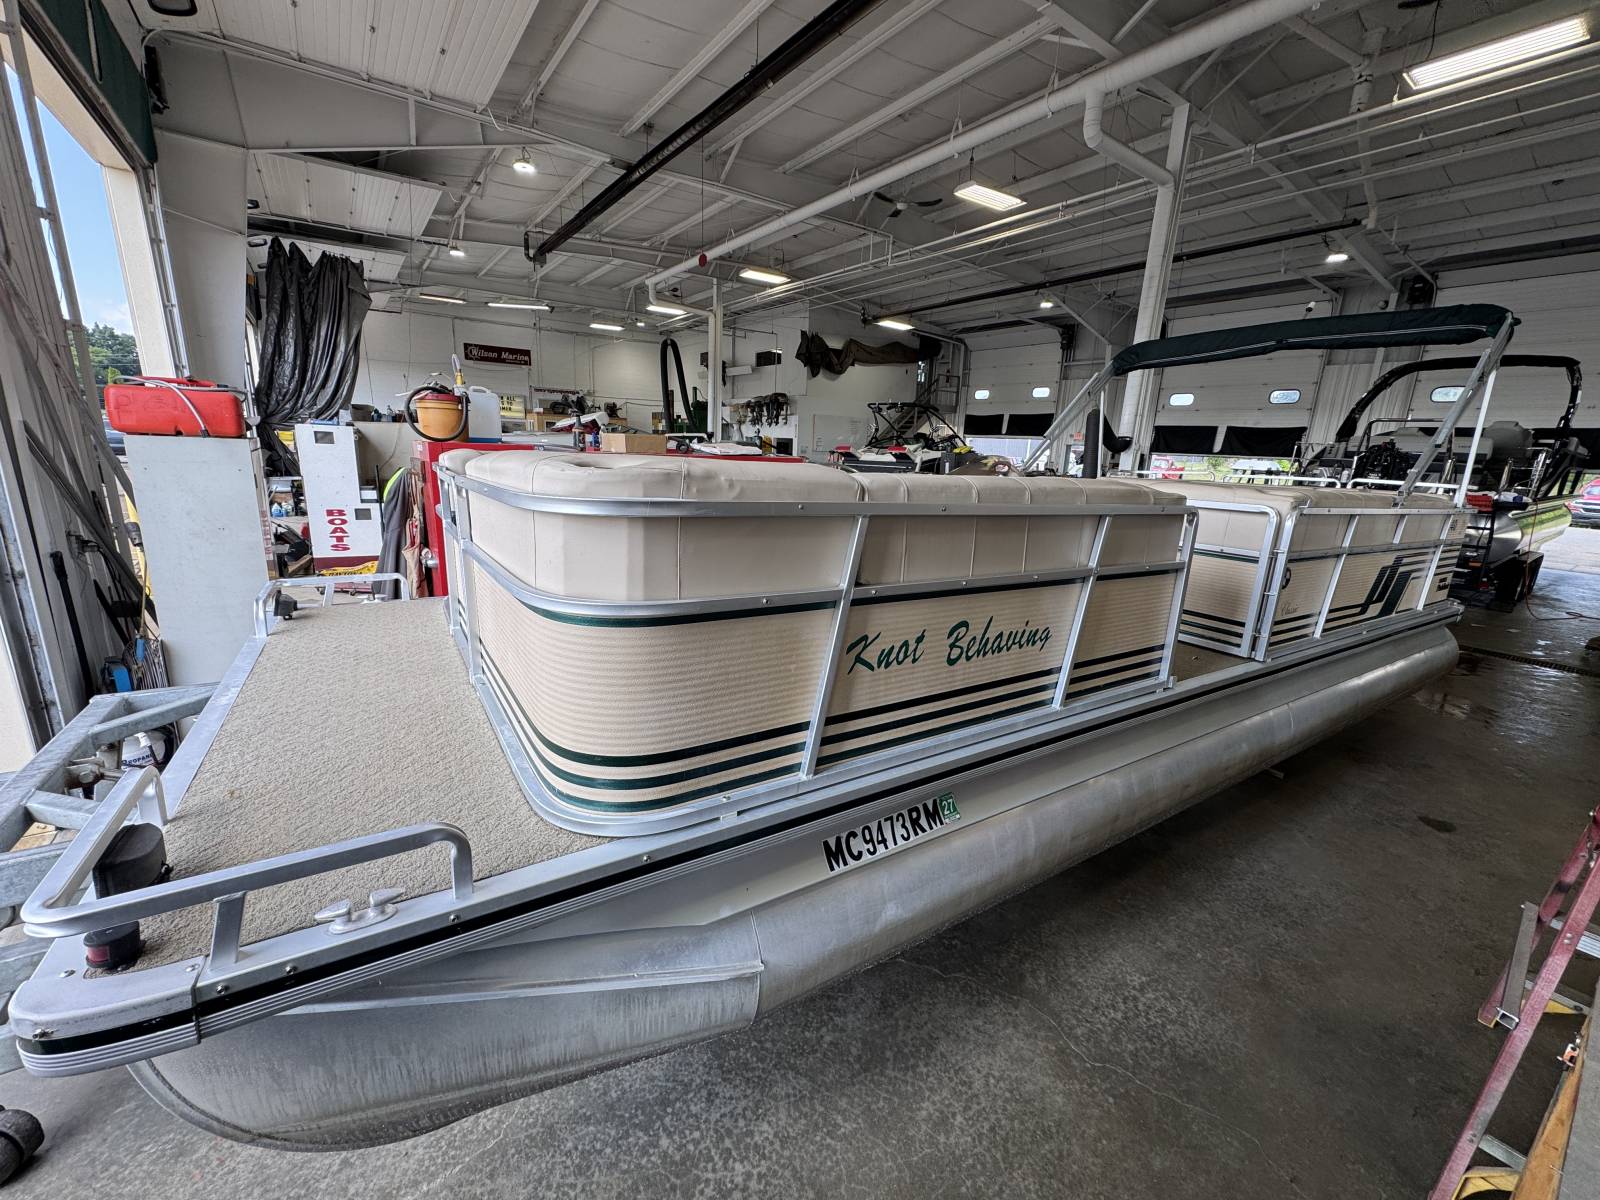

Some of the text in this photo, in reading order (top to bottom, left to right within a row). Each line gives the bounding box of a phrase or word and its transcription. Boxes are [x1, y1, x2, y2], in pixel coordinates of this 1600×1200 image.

[470, 347, 529, 361] Wilson Marine
[326, 509, 351, 551] BOATS
[846, 616, 1052, 675] Knot Behaving
[121, 754, 152, 766] PROPAN
[942, 799, 954, 815] 27
[822, 799, 944, 873] MC9473RM
